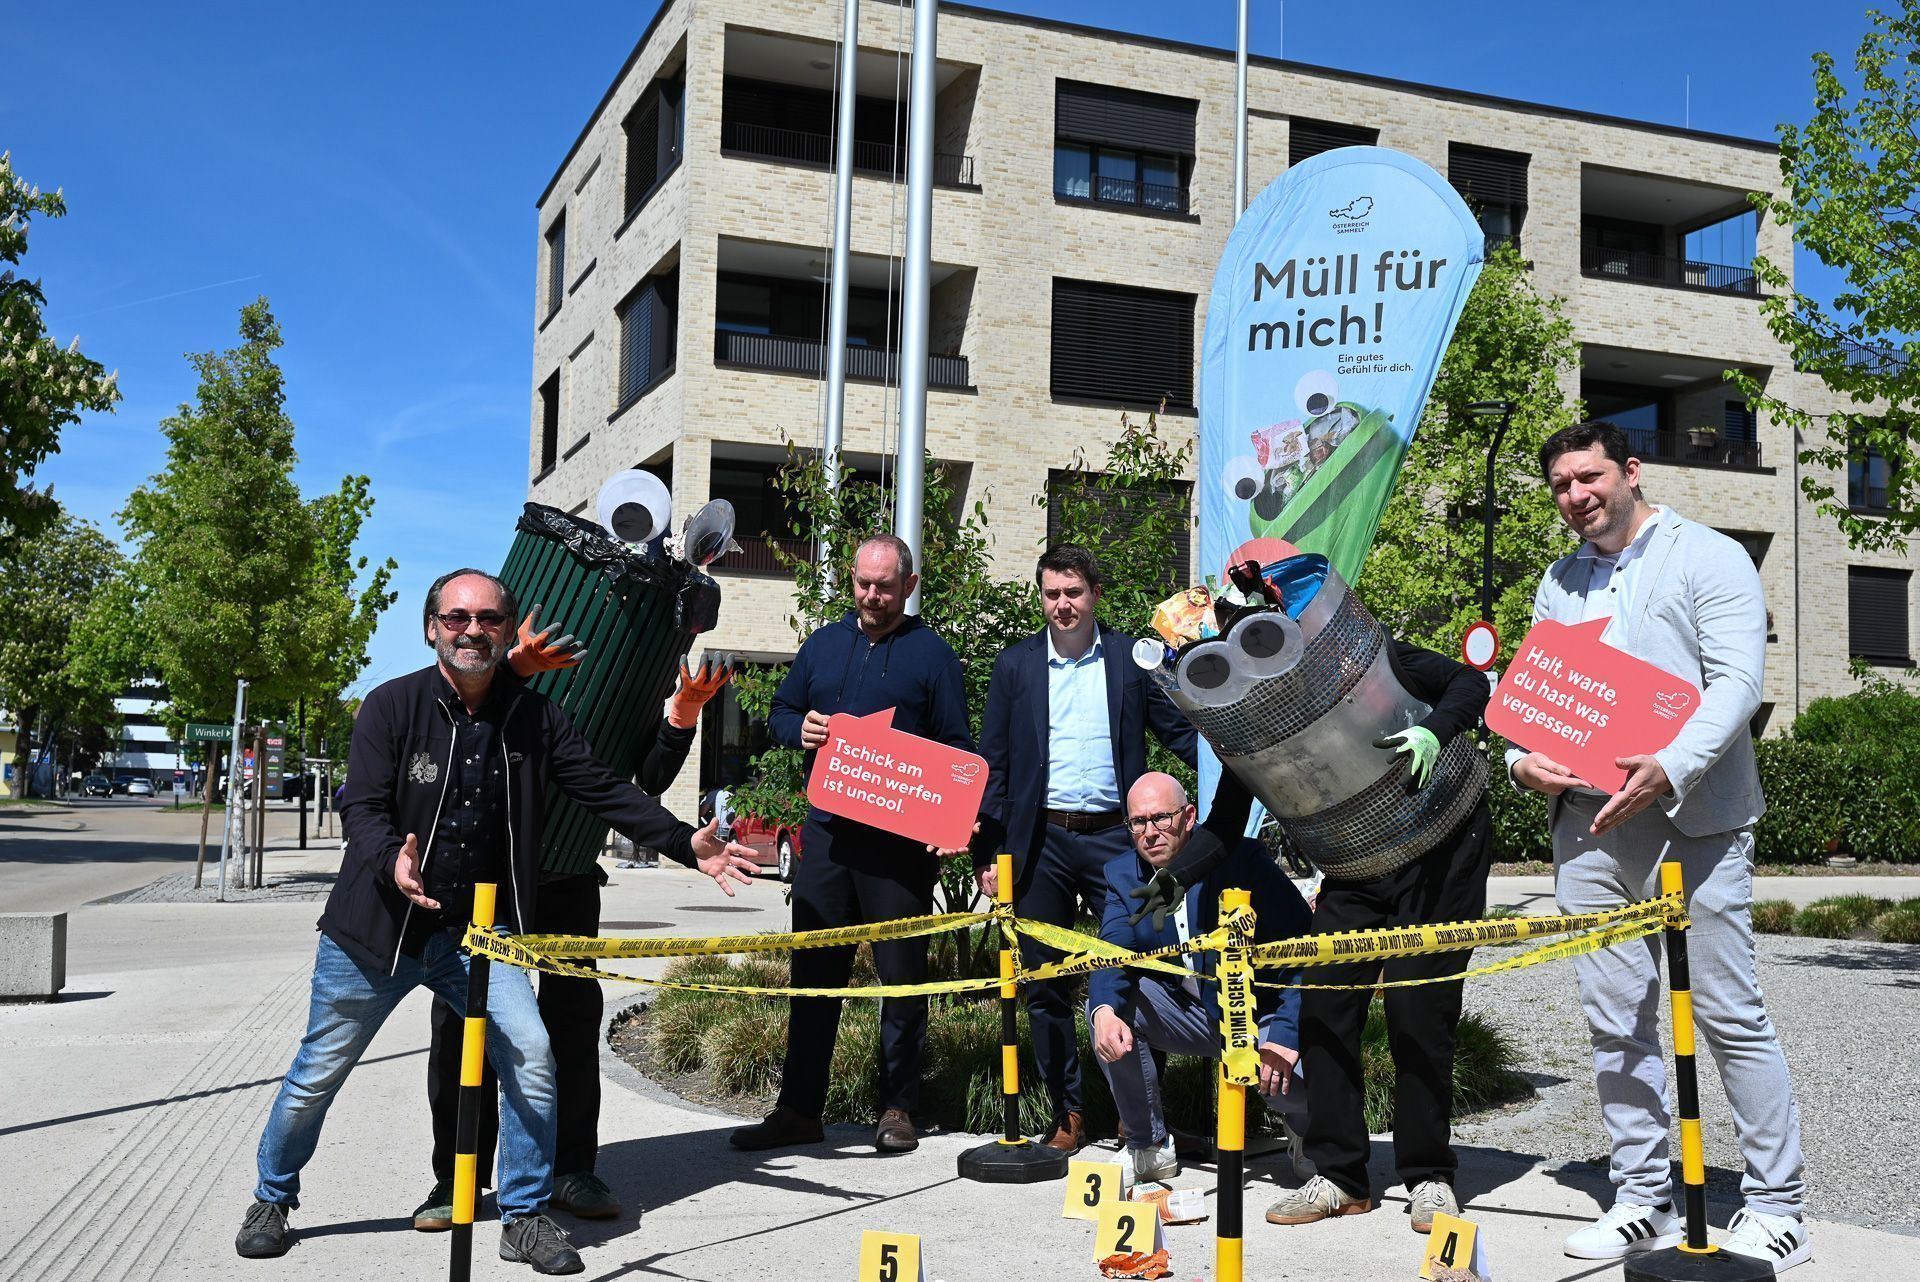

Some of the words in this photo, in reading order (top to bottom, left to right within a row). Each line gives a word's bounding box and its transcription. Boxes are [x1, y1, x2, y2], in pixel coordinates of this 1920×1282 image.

[1332, 221, 1370, 229] ÖSTERREICH
[1337, 227, 1365, 235] SAMMELT
[1253, 253, 1359, 302] Müll
[1373, 249, 1447, 293] für
[1248, 302, 1384, 352] mich!
[1337, 364, 1371, 375] Gefühl
[1373, 364, 1388, 373] für
[1389, 363, 1414, 373] dich.
[1338, 354, 1354, 363] Ein
[1356, 353, 1384, 365] gutes
[1525, 645, 1563, 679] Halt,
[1567, 668, 1619, 707] warte,
[1513, 670, 1537, 692] du
[1537, 679, 1576, 712] hast
[1575, 702, 1610, 729] was
[195, 728, 224, 737] Winkel
[1502, 692, 1593, 748] vergessen!
[835, 737, 896, 770] Tschick
[897, 762, 923, 779] am
[823, 775, 844, 794] ist
[846, 785, 905, 814] uncool.
[828, 756, 882, 786] Boden
[885, 777, 943, 805] werfen
[1332, 940, 1354, 955] CRIME
[1354, 937, 1375, 953] SCENE
[1378, 936, 1388, 950] DO
[1388, 934, 1402, 949] NOT
[1401, 933, 1424, 948] CROSS
[1435, 930, 1456, 945] CRIME
[1456, 928, 1475, 942] SCENE
[1477, 927, 1487, 941] DO
[1487, 925, 1498, 940] NOT
[1498, 923, 1517, 937] CROSS
[1527, 921, 1546, 935] CRIME
[1545, 919, 1562, 933] SCENE
[1564, 919, 1573, 932] DO
[1572, 918, 1583, 930] NOT
[1582, 917, 1598, 929] CROSS
[470, 934, 490, 949] RIME
[490, 938, 510, 957] SCENE
[514, 948, 525, 961] DO
[1266, 945, 1280, 958] DO
[1279, 944, 1295, 958] NOT
[1295, 941, 1318, 957] CROSS
[1227, 970, 1246, 1009] SCENE
[1230, 1009, 1248, 1049] CRIME
[1083, 1173, 1102, 1207] 3
[1115, 1215, 1136, 1253] 2
[1439, 1231, 1458, 1268] 4
[879, 1243, 898, 1282] 5
